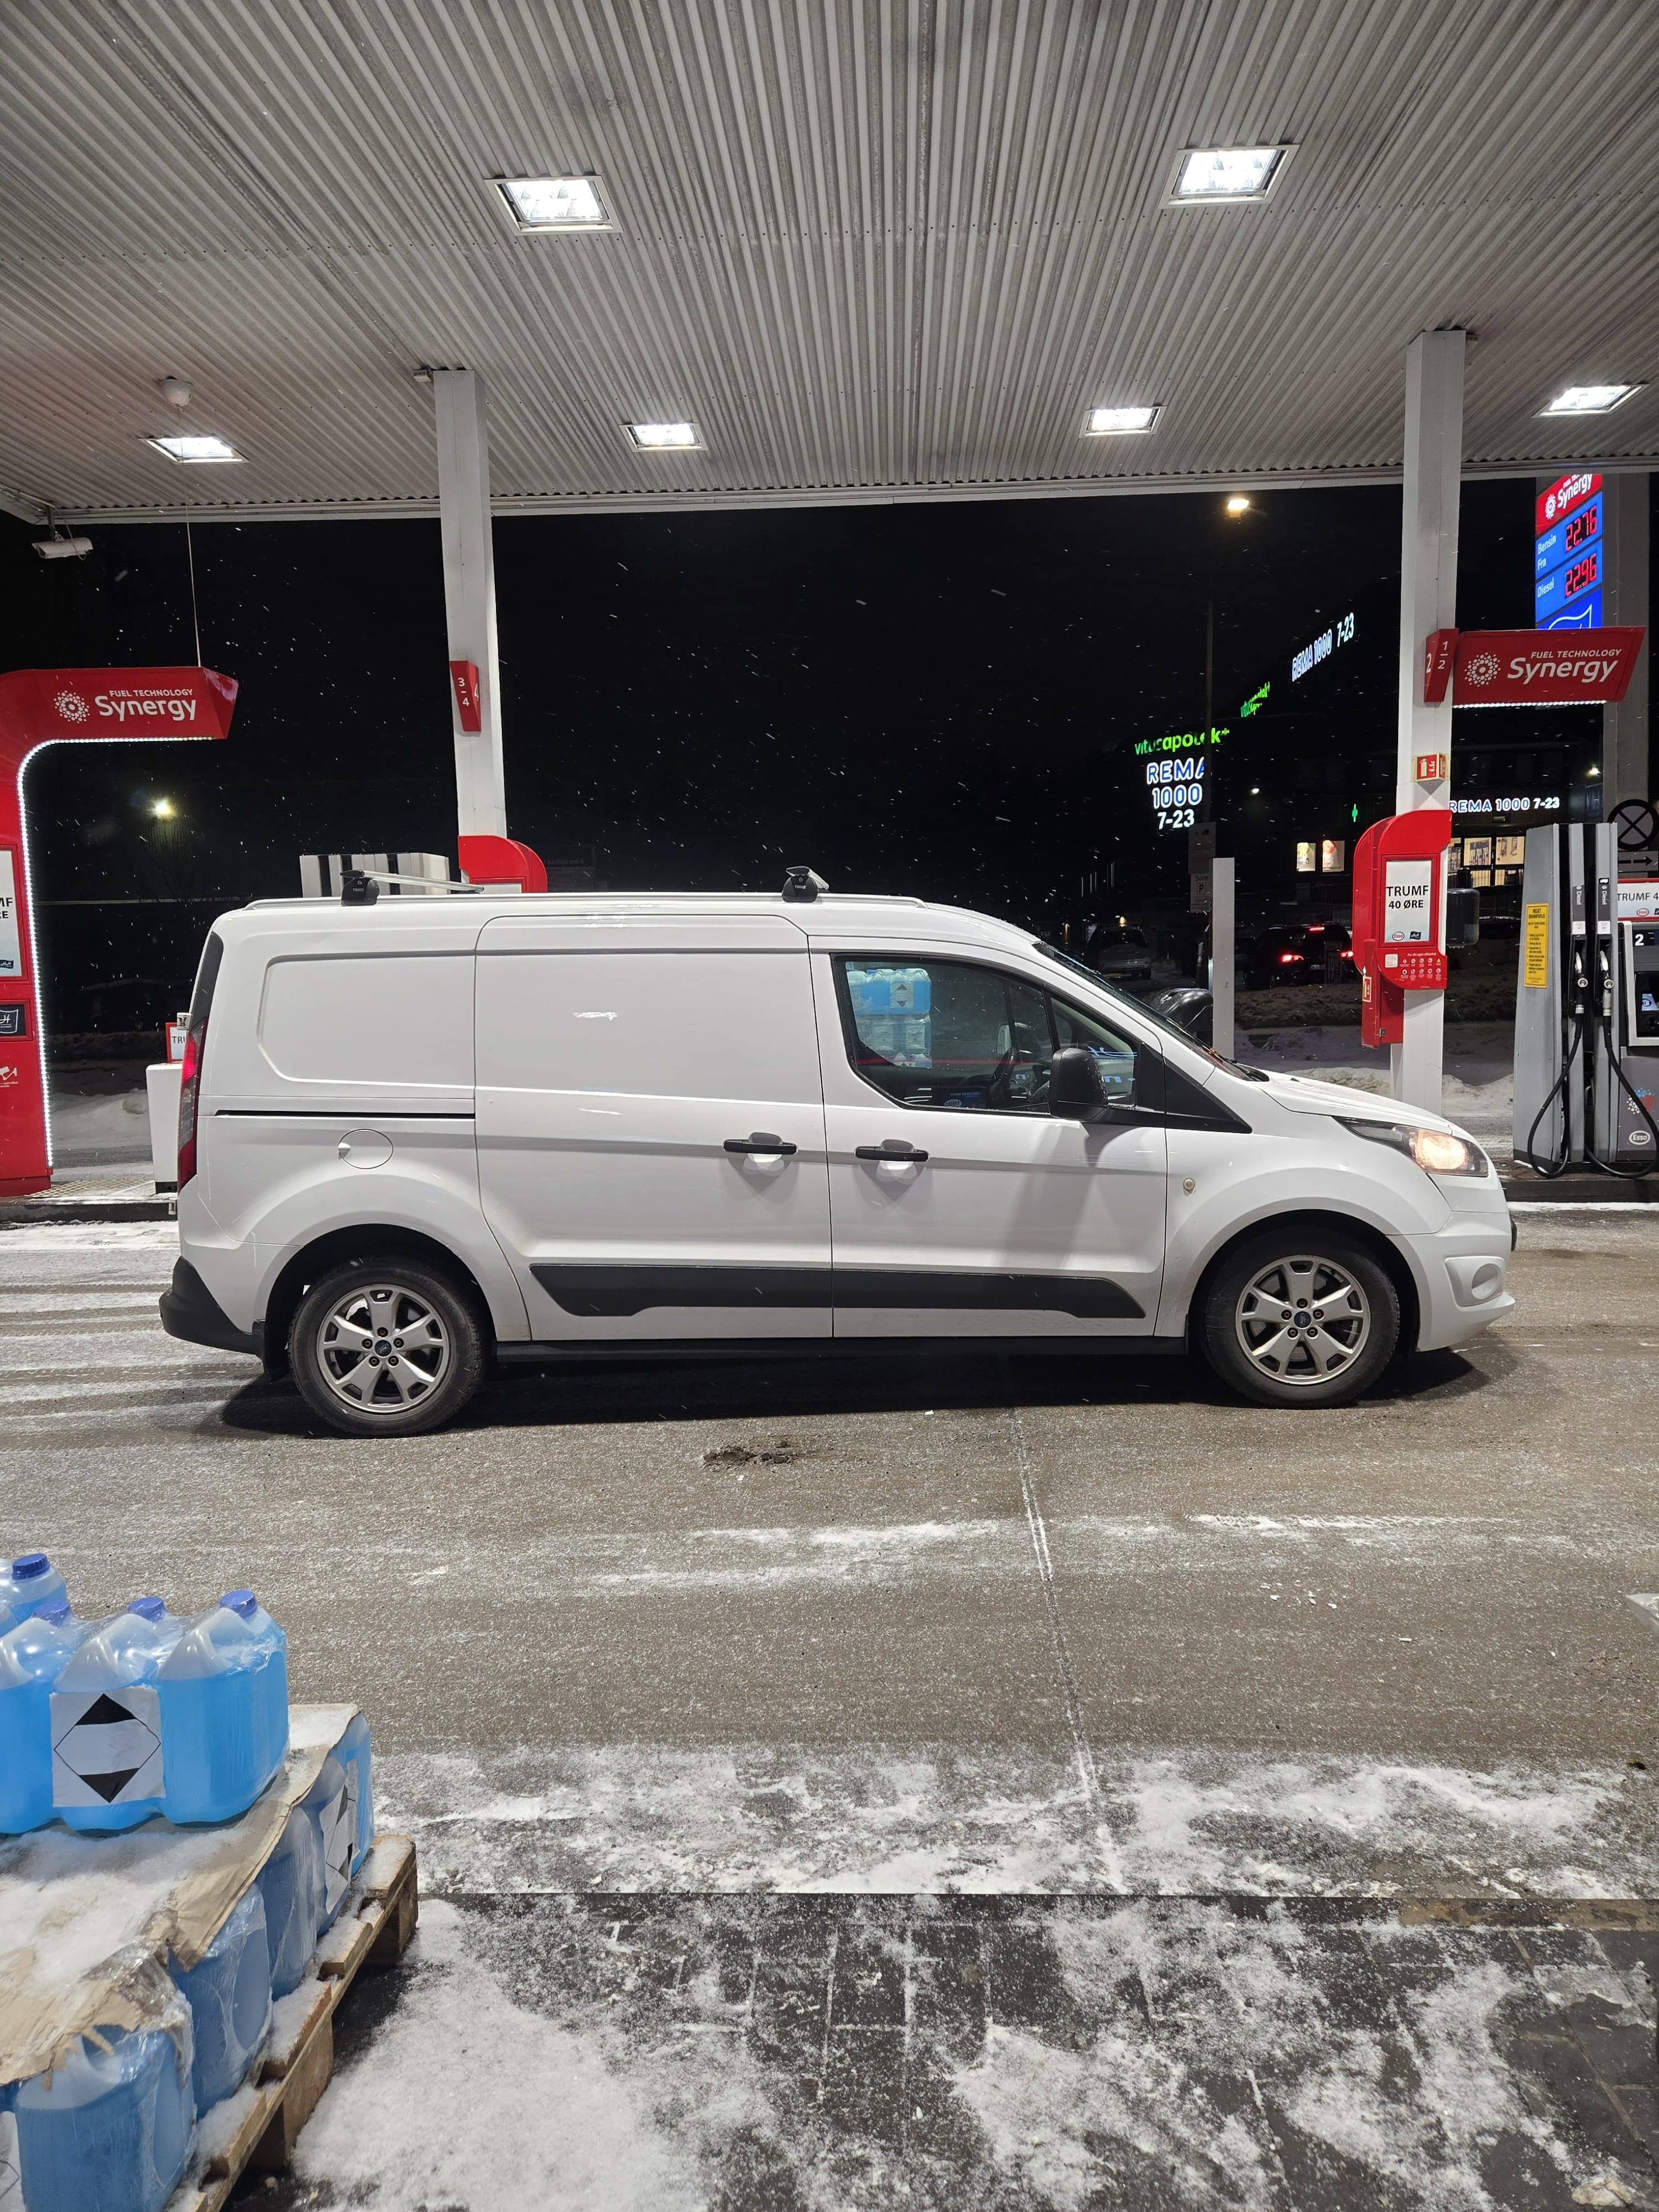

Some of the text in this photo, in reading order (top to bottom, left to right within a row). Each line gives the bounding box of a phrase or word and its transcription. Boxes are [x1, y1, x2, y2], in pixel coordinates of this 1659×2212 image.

[1557, 474, 1593, 509] Synergy
[1537, 534, 1556, 555] Bensin
[1537, 559, 1546, 571] Fra
[1537, 577, 1554, 598] Diesel
[1292, 612, 1354, 682] REMA 1000 7-23
[1557, 649, 1622, 658] TECHNOLOGY
[1426, 653, 1432, 674] 2
[1437, 660, 1446, 669] 2
[1507, 657, 1619, 685] Synergy
[457, 677, 465, 687] 3
[133, 689, 193, 697] TECHNOLOGY
[474, 682, 479, 702] 4
[95, 696, 196, 722] Synergy
[462, 697, 469, 707] 4
[1152, 783, 1203, 809] 1000
[1448, 797, 1560, 813] REMA 1000 7-23
[1157, 809, 1194, 830] 7-23
[1198, 884, 1204, 893] P
[1386, 885, 1428, 897] TRUMF
[1618, 893, 1650, 901] TRUMF
[1389, 899, 1424, 910] 40 ØRE
[1635, 934, 1644, 946] 2
